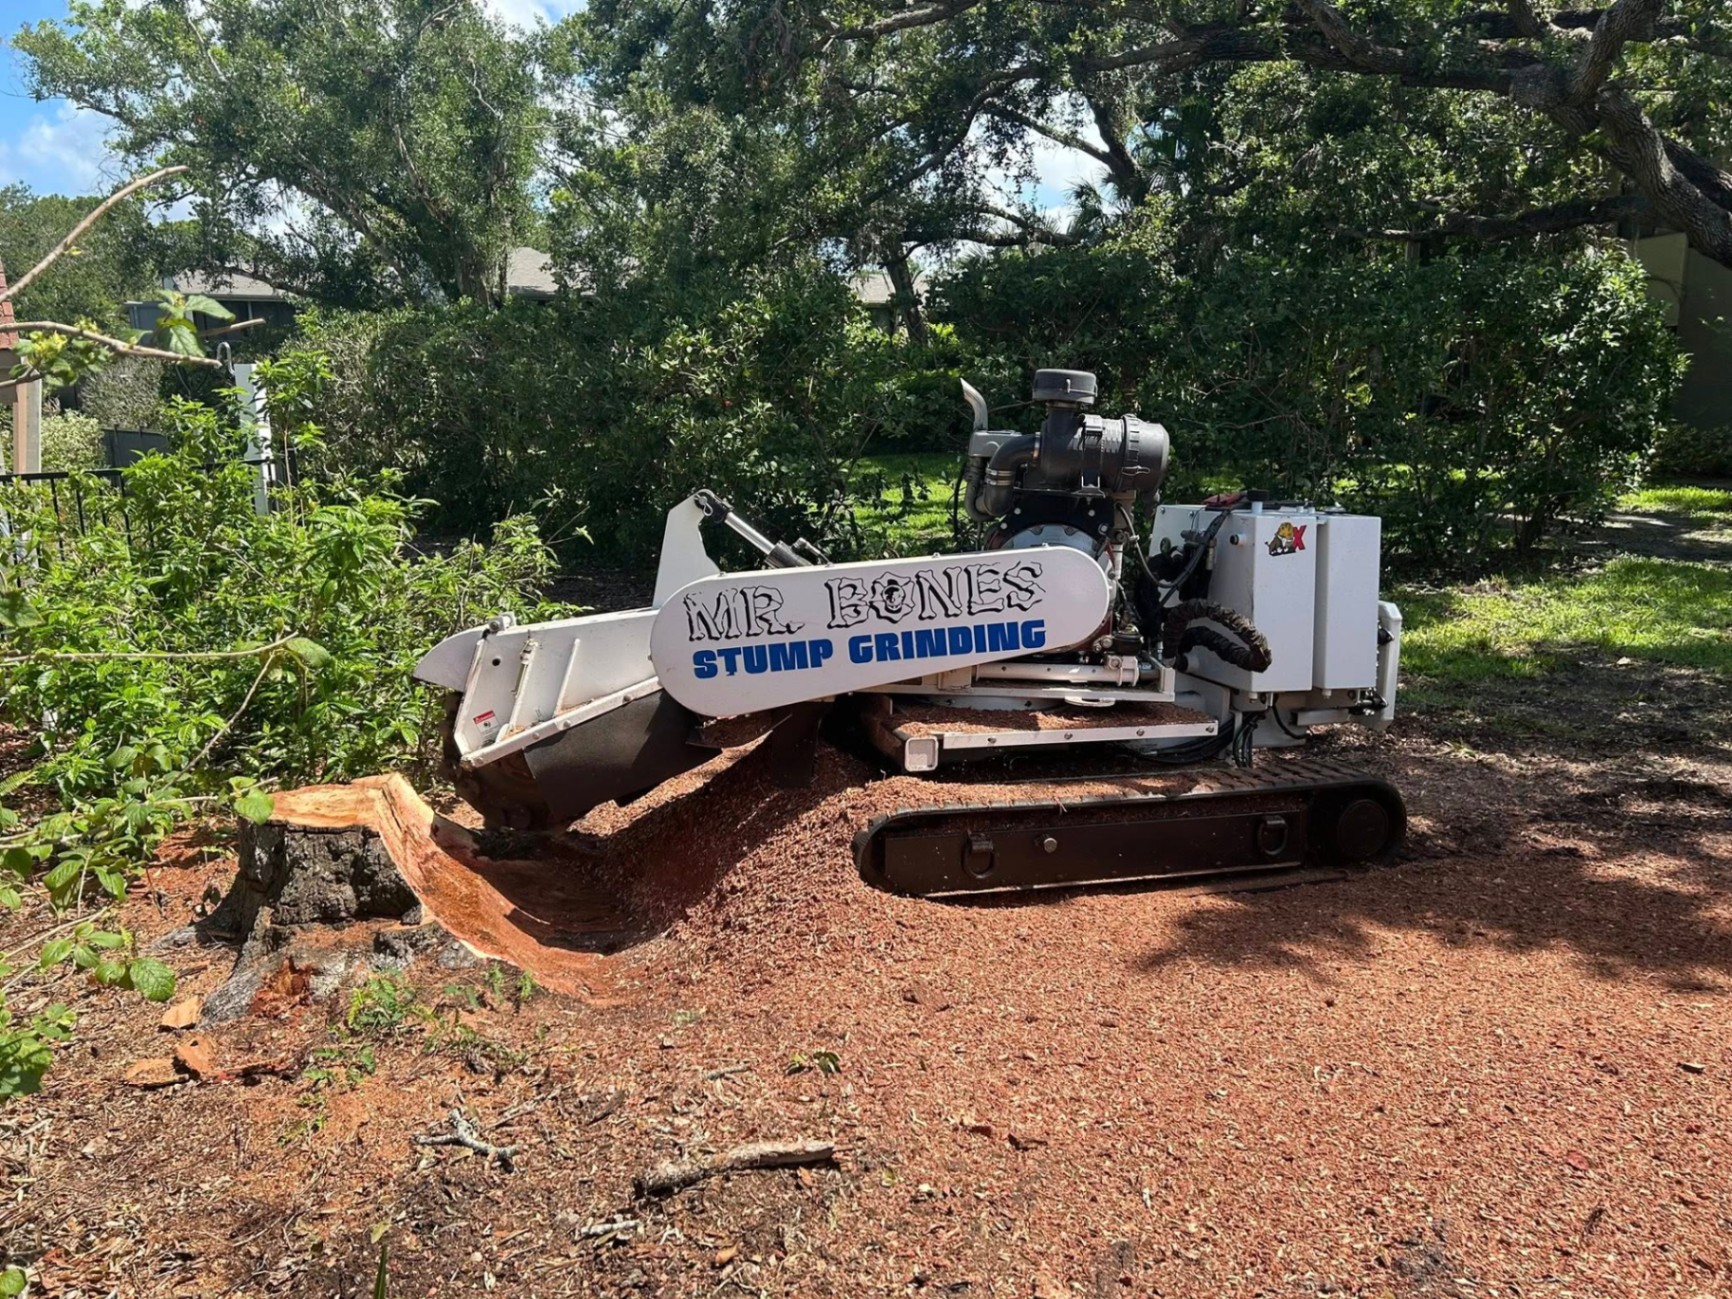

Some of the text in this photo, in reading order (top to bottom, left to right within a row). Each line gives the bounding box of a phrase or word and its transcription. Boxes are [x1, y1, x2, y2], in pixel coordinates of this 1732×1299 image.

[1292, 525, 1307, 550] X
[683, 561, 1046, 641] MR. BONES
[693, 619, 1046, 680] STUMP GRINDING
